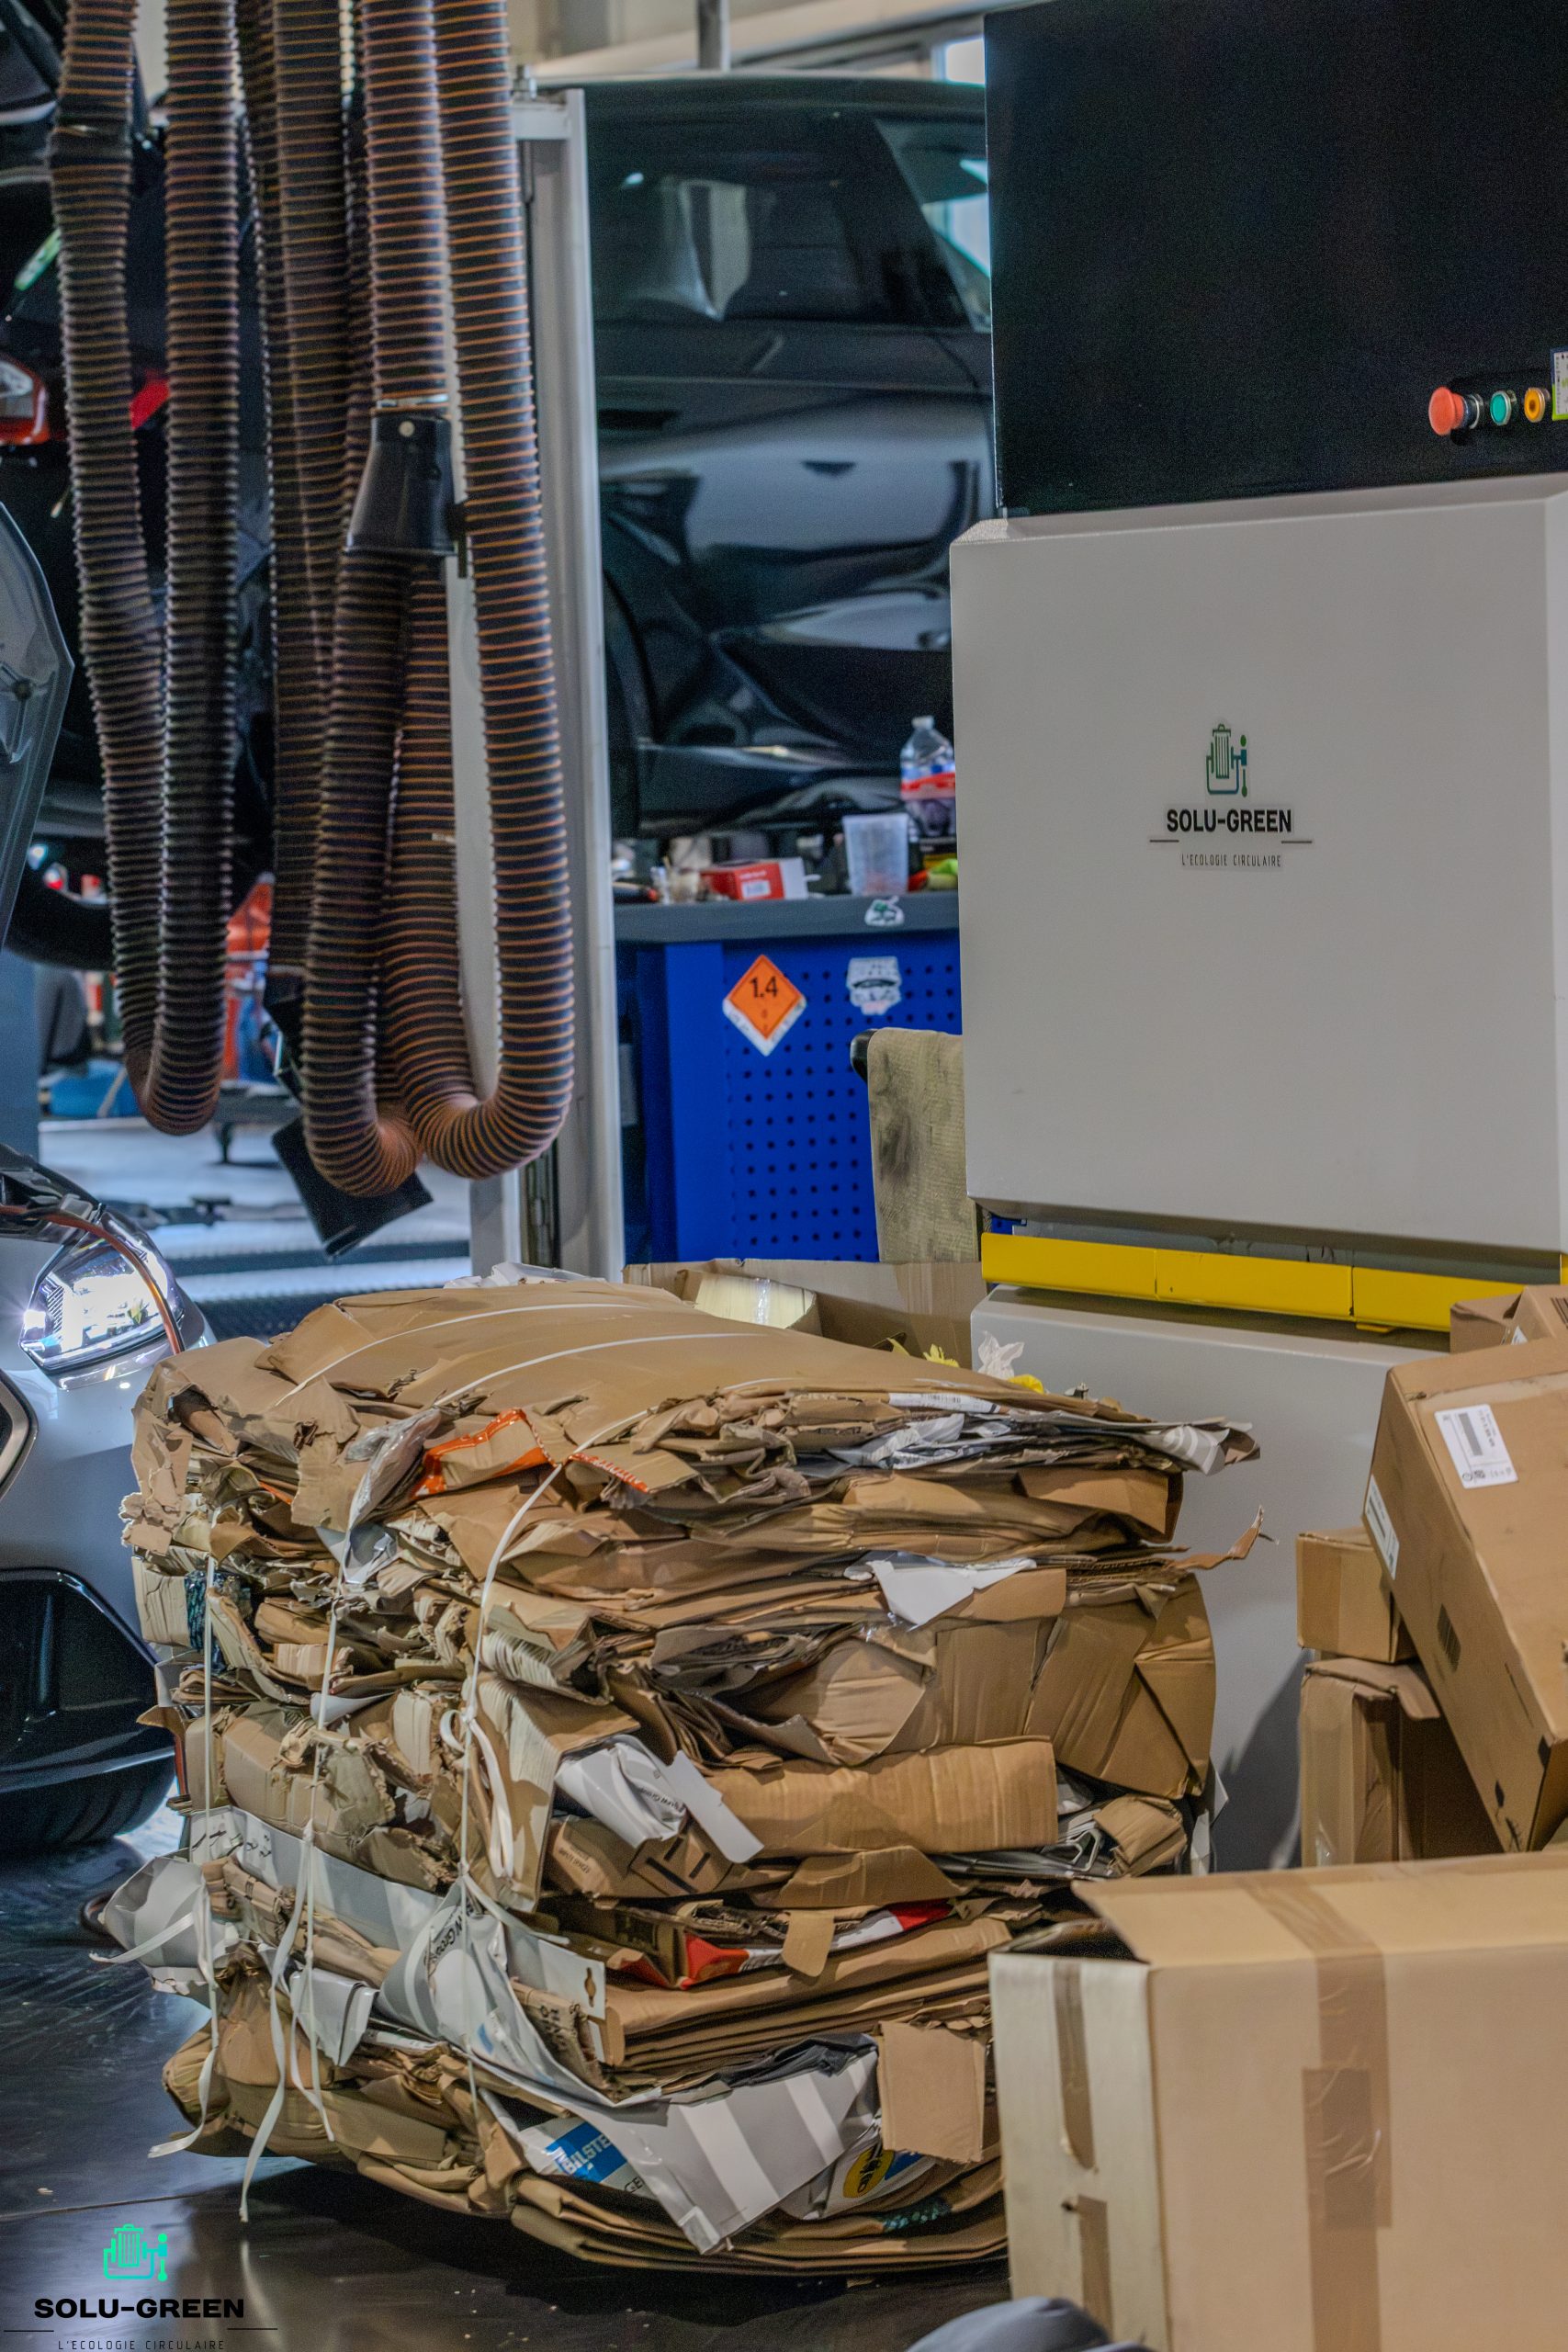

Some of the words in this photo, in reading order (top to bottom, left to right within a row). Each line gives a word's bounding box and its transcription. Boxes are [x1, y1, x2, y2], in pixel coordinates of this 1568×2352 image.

[1167, 808, 1292, 832] SOLU-GREEN
[1181, 854, 1227, 866] L'ECOLOGIE
[1233, 854, 1281, 867] CIRCULAIRE
[750, 976, 779, 999] 1.4
